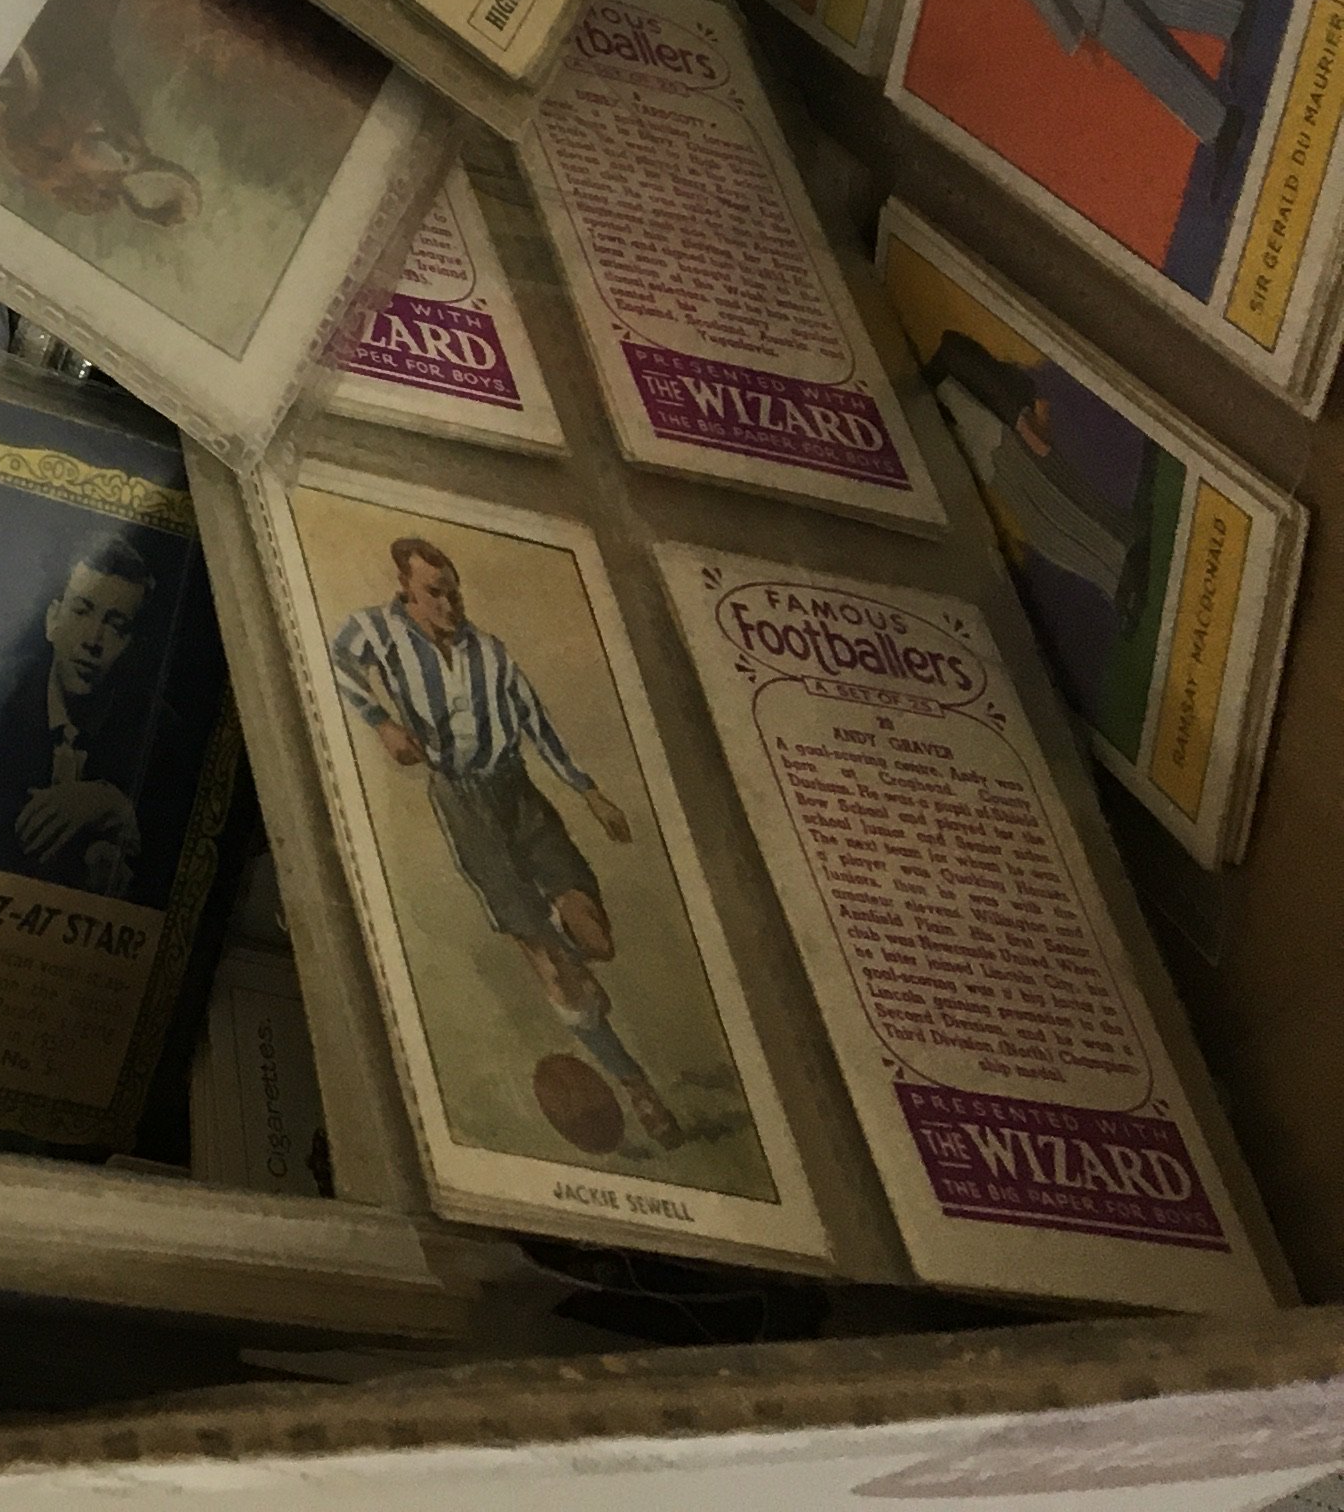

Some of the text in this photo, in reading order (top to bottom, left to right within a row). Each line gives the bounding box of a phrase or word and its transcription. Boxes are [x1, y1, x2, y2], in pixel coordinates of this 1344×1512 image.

[1249, 12, 1344, 314] SIR GERALD DU MAURIER
[410, 302, 482, 329] WITH
[406, 359, 445, 378] FOR
[634, 350, 866, 410] PRESENTED WITH
[642, 375, 884, 452] THE WIZARD
[765, 589, 908, 635] FAMOUS
[730, 602, 973, 691] Footballers
[1173, 516, 1227, 769] RAMSAY MACDONALD
[833, 727, 954, 760] ANDY GRAVER
[61, 913, 146, 959] STAR?
[266, 1016, 291, 1179] Cigarettes.
[912, 1093, 1168, 1142] PRESENTED WITH
[921, 1124, 1191, 1202] THE WIZARD
[553, 1181, 695, 1223] JACKIE SEWELL
